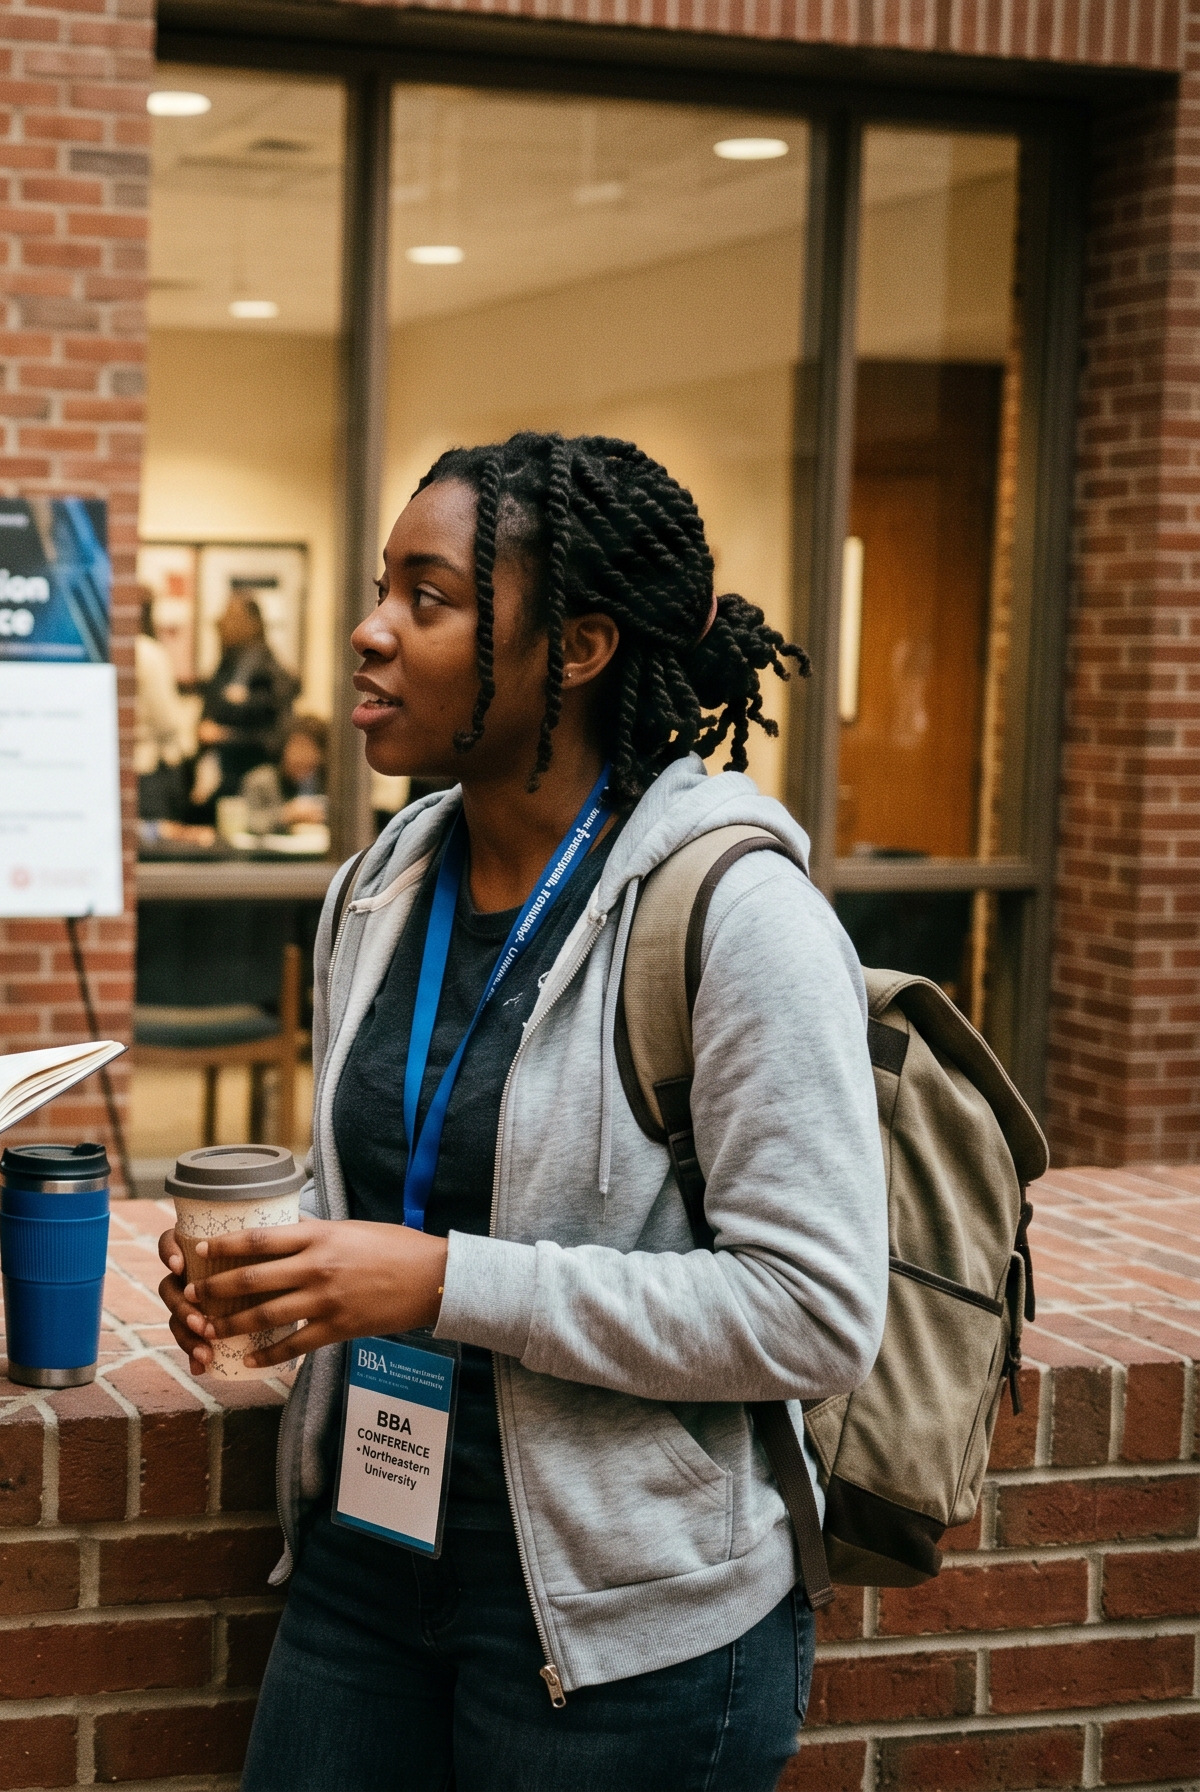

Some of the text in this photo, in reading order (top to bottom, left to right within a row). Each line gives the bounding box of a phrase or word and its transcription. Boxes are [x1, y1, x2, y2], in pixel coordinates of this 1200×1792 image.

[358, 1348, 387, 1374] BBA
[377, 1410, 412, 1435] BBA
[357, 1428, 430, 1459] CONFERENCE
[362, 1445, 430, 1476] Northeastern
[364, 1462, 417, 1490] University
